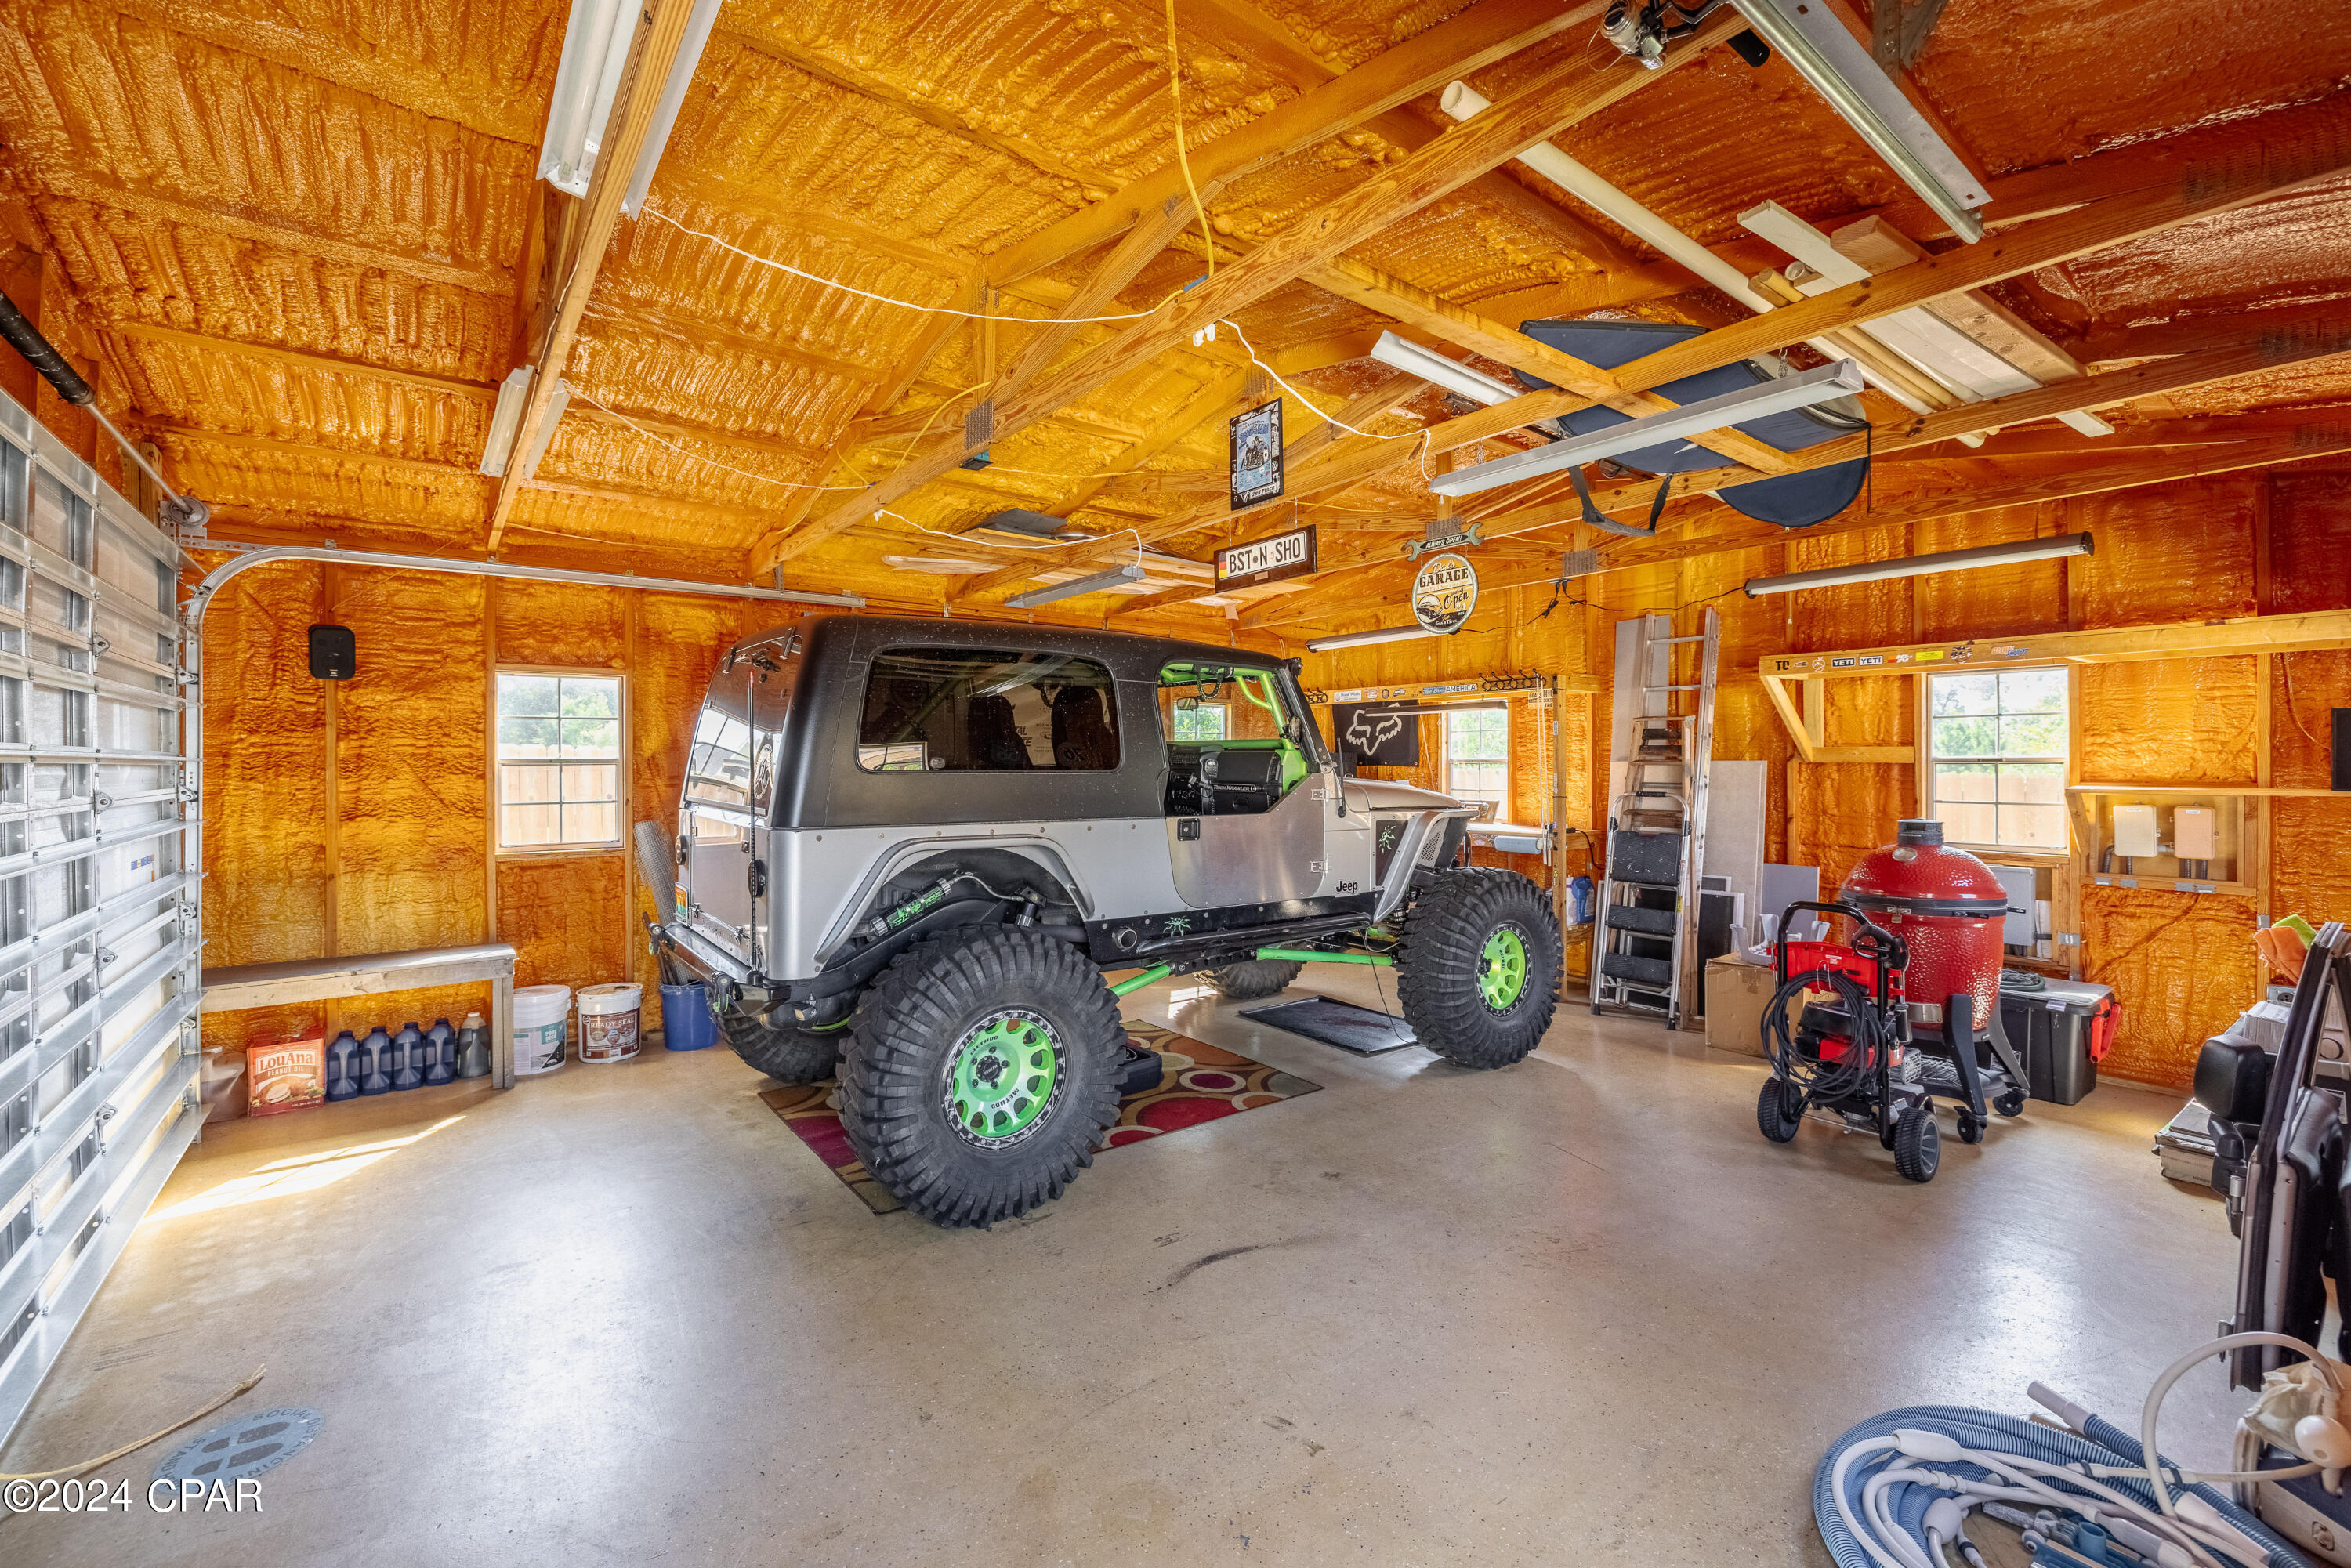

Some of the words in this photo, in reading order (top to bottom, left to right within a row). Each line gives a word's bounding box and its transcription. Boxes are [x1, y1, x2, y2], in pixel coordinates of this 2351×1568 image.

[1252, 489, 1261, 498] 2nd
[1261, 485, 1276, 495] Place
[1425, 539, 1445, 549] ALWAYS
[1445, 535, 1462, 545] OPEN!
[1275, 537, 1301, 563] SHO
[1433, 559, 1456, 574] Dad's
[1419, 567, 1469, 588] GARAGE
[1443, 592, 1469, 610] Open
[1446, 684, 1476, 693] AMERICA
[1335, 880, 1358, 893] Jeep
[618, 1017, 635, 1027] SEAL
[970, 1035, 998, 1056] METHOD
[259, 1052, 313, 1072] LouAna
[267, 1066, 292, 1077] PEANUT
[991, 1088, 1020, 1109] METHOD
[252, 1408, 311, 1421] SOCIAL
[161, 1437, 207, 1472] STAND
